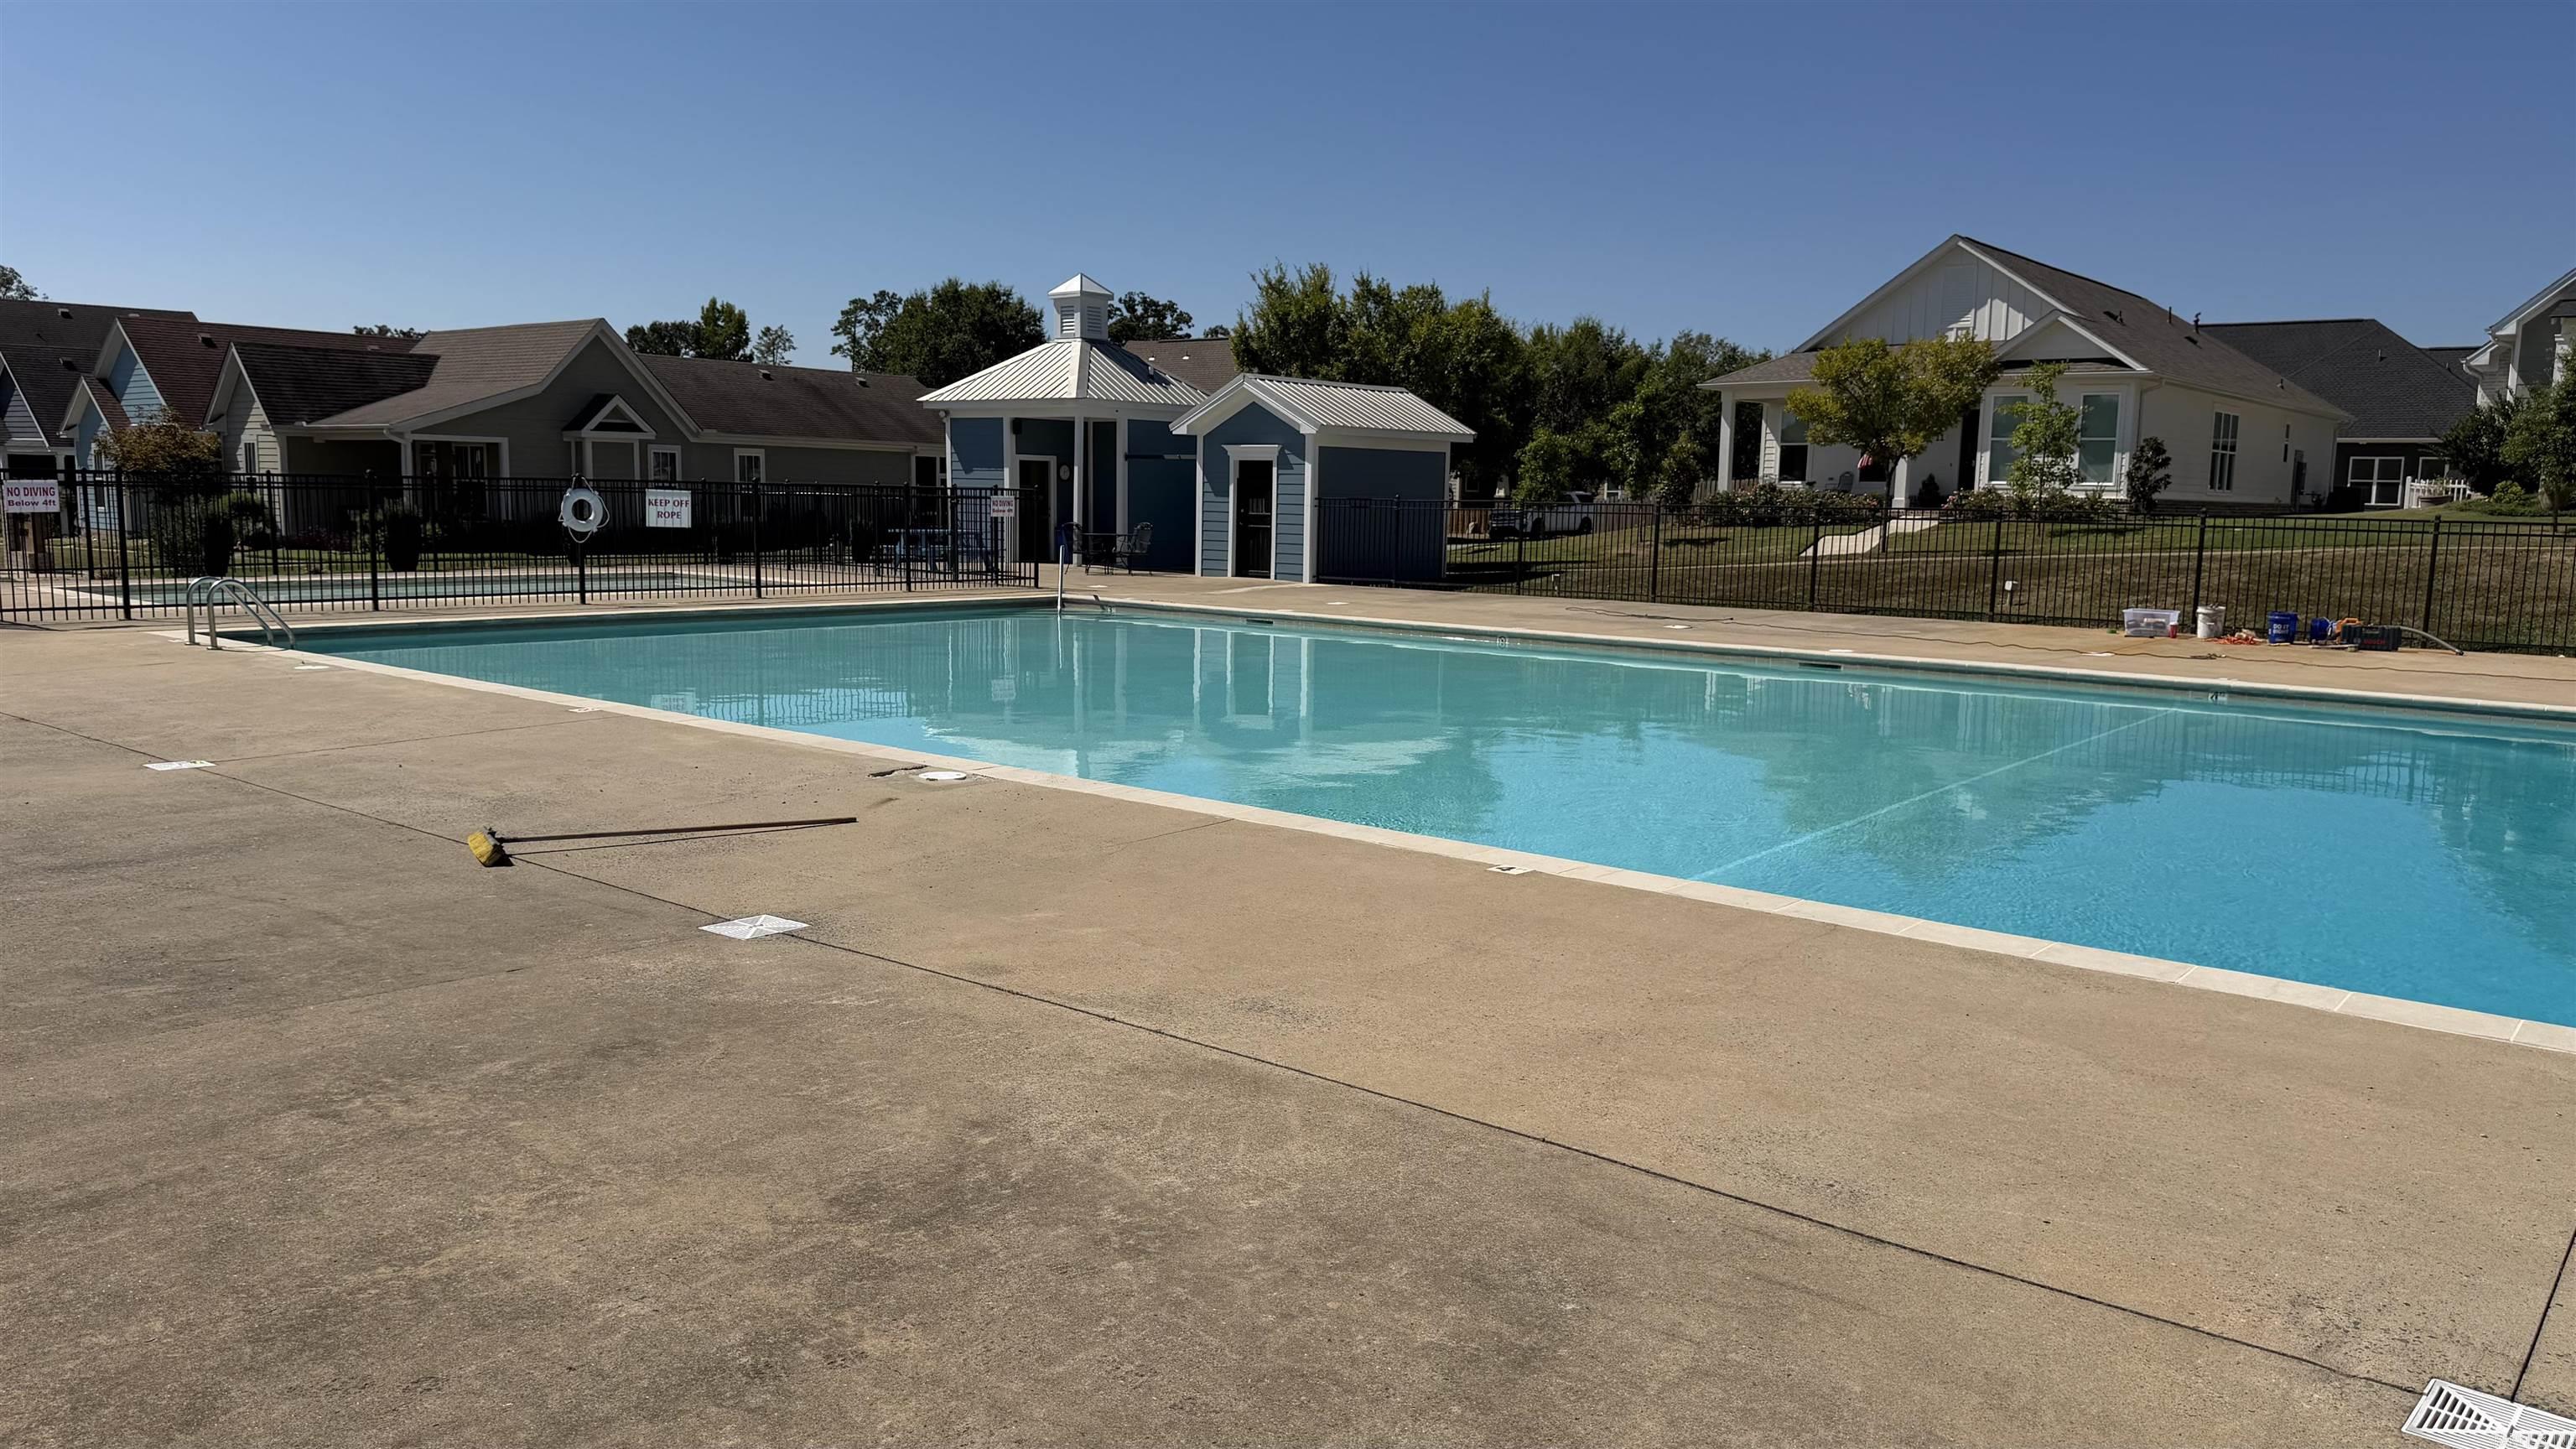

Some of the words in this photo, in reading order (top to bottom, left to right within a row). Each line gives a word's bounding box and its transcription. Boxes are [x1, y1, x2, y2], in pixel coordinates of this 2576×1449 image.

[7, 486, 20, 496] NO
[23, 486, 55, 496] DIVING
[648, 498, 670, 506] KEEP
[673, 499, 689, 507] OFF
[657, 511, 682, 519] ROPE
